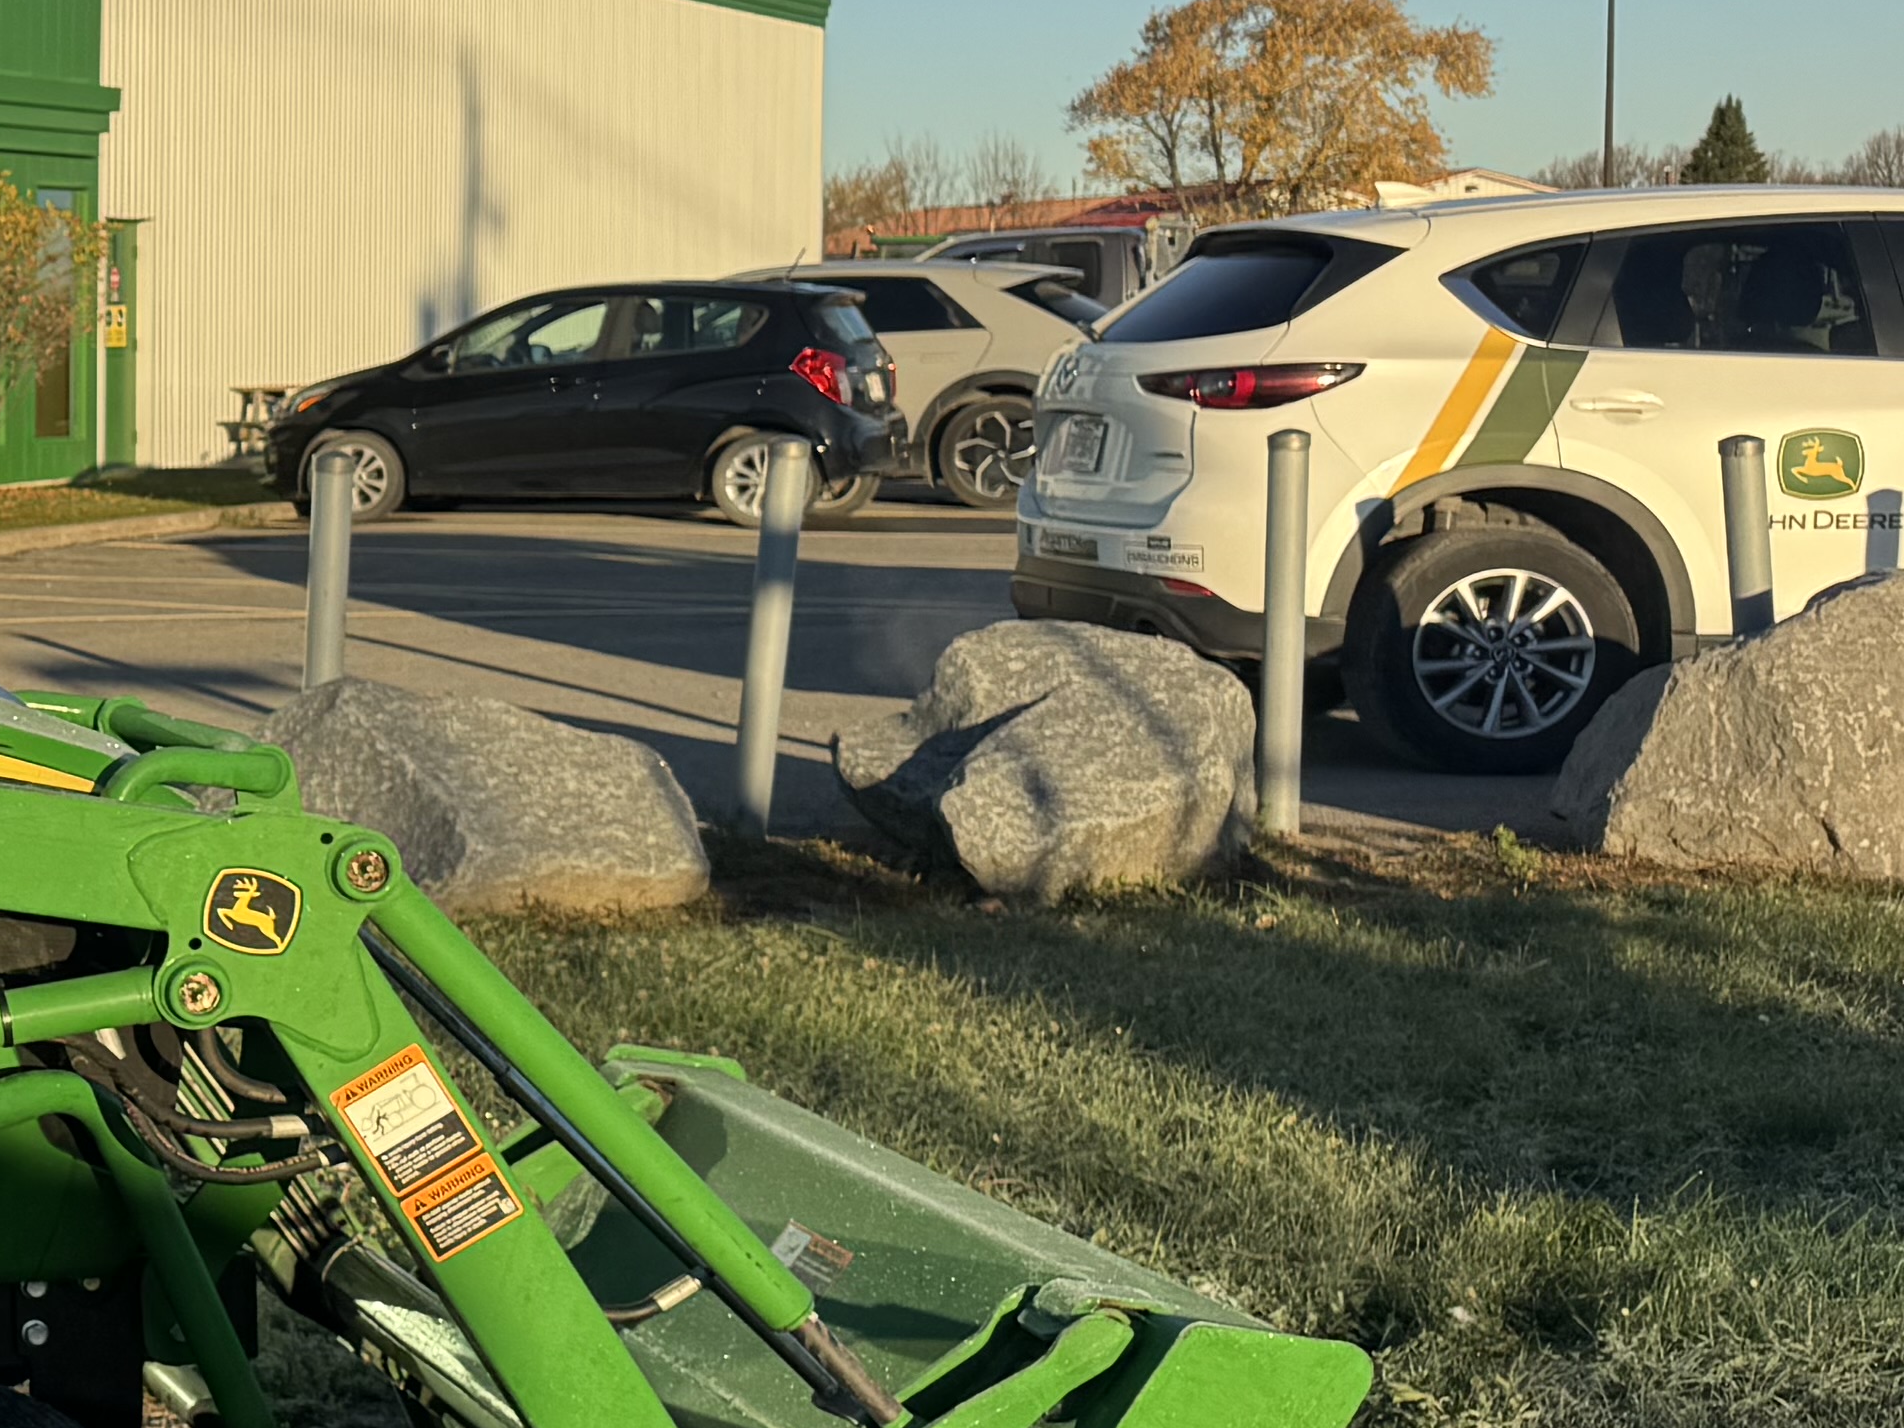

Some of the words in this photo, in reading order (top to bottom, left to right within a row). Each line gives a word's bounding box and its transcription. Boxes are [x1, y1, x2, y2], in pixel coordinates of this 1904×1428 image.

[1769, 514, 1806, 530] HN
[1813, 510, 1903, 530] DEERE
[357, 1054, 414, 1093] WARNING
[428, 1163, 486, 1202] WARNING
